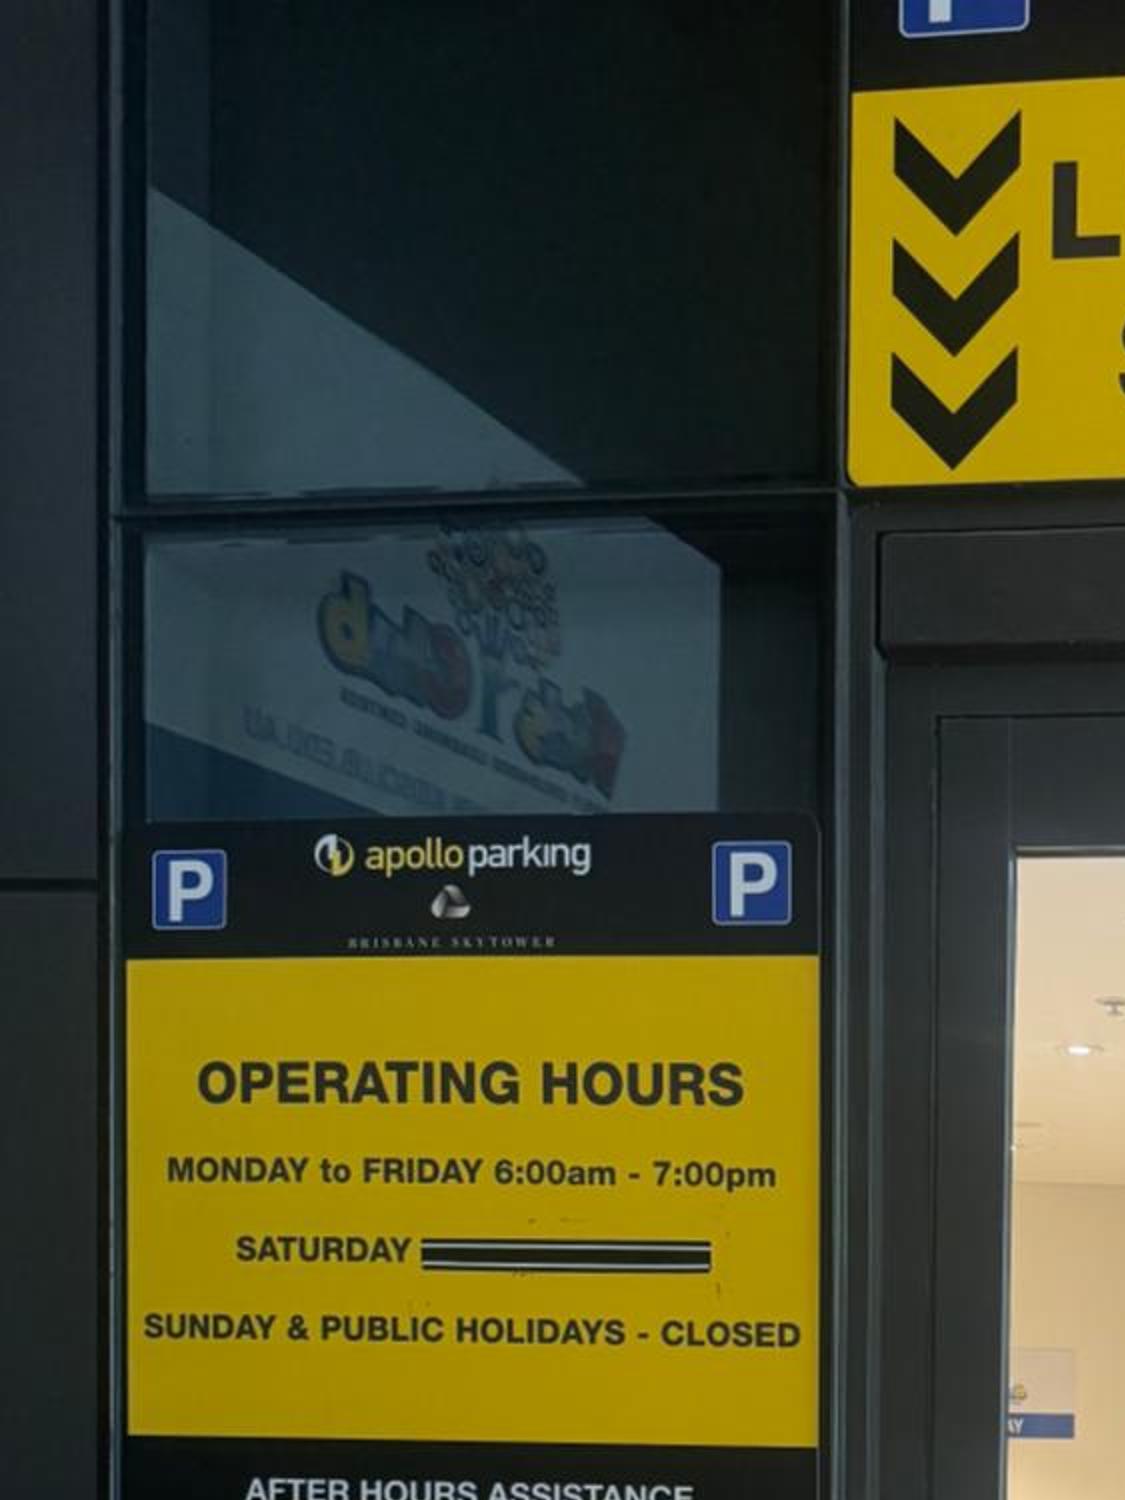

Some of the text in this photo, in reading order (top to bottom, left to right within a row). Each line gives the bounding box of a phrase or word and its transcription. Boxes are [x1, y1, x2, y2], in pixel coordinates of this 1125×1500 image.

[365, 835, 592, 878] apollo parking
[169, 859, 214, 922] P
[730, 852, 778, 917] P
[348, 935, 556, 949] BRISBANE SKYTOWER
[197, 1061, 744, 1107] OPERATING HOURS
[167, 1157, 308, 1184] MONDAY
[320, 1160, 352, 1184] to
[364, 1159, 483, 1185] FRIDAY
[494, 1160, 616, 1187] 6:00am
[653, 1161, 777, 1193] 7:00pm
[236, 1236, 411, 1263] SATURDAY
[143, 1313, 276, 1340] SUNDAY
[287, 1315, 309, 1341] &
[321, 1316, 444, 1343] PUBLIC
[456, 1318, 626, 1346] HOLIDAYS
[661, 1321, 801, 1349] CLOSED
